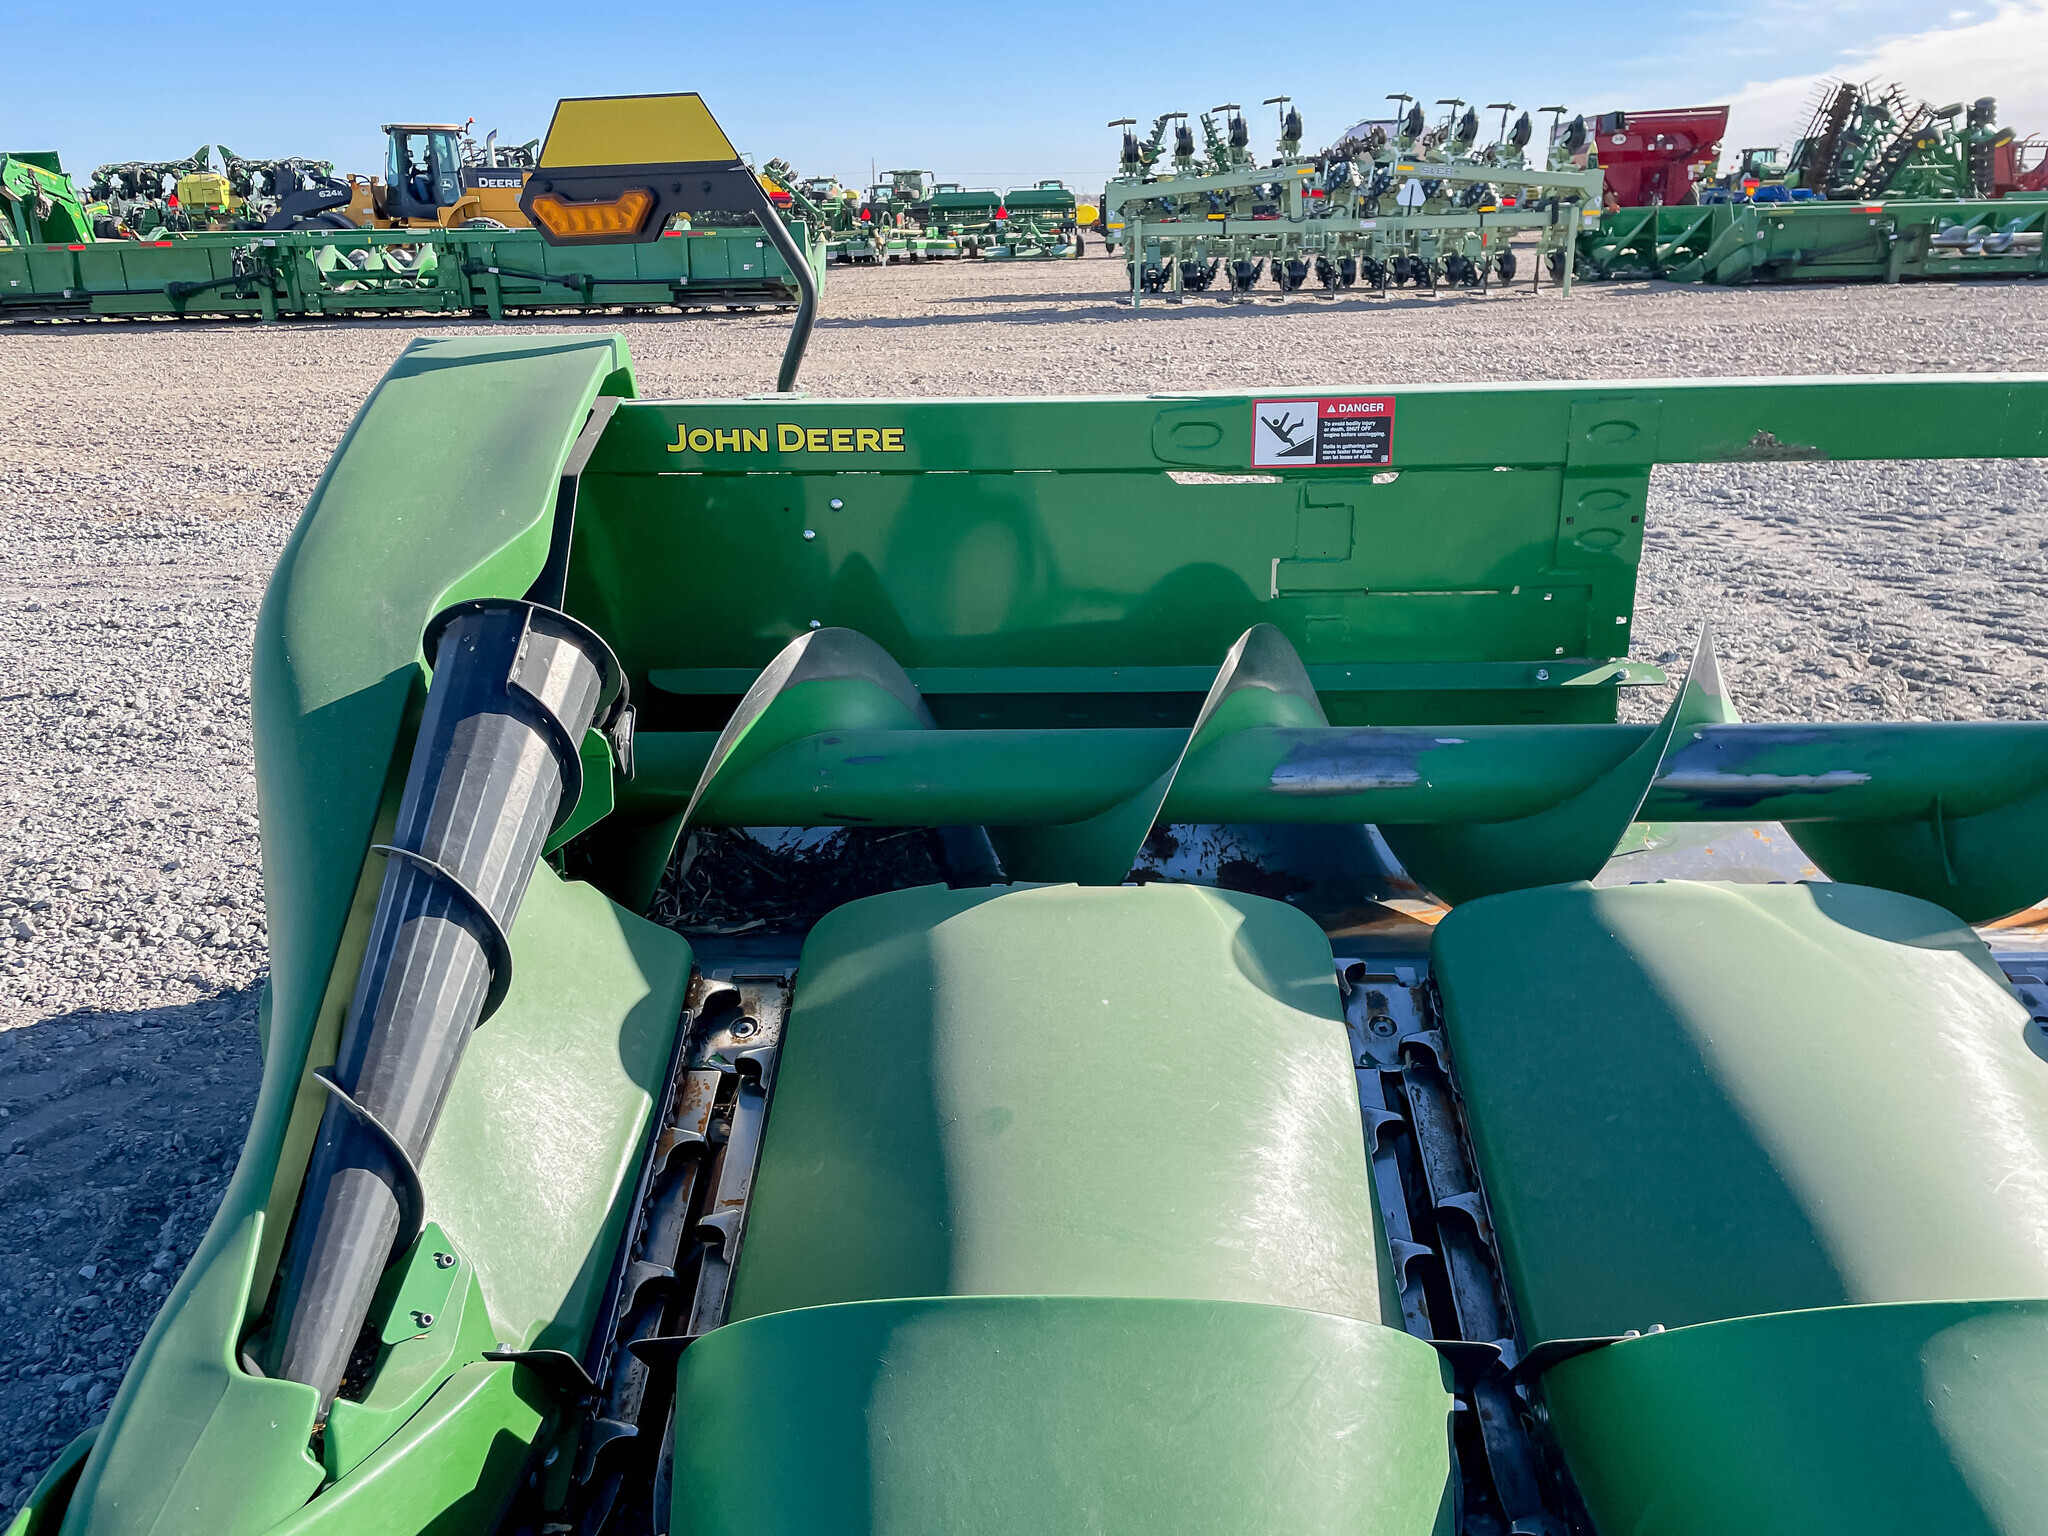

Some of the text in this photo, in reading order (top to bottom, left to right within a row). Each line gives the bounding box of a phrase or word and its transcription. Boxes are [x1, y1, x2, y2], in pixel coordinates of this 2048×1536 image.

[478, 177, 522, 188] DEERE
[318, 189, 344, 198] 624K
[1338, 403, 1384, 412] DANGER
[666, 423, 905, 453] JOHN DEERE
